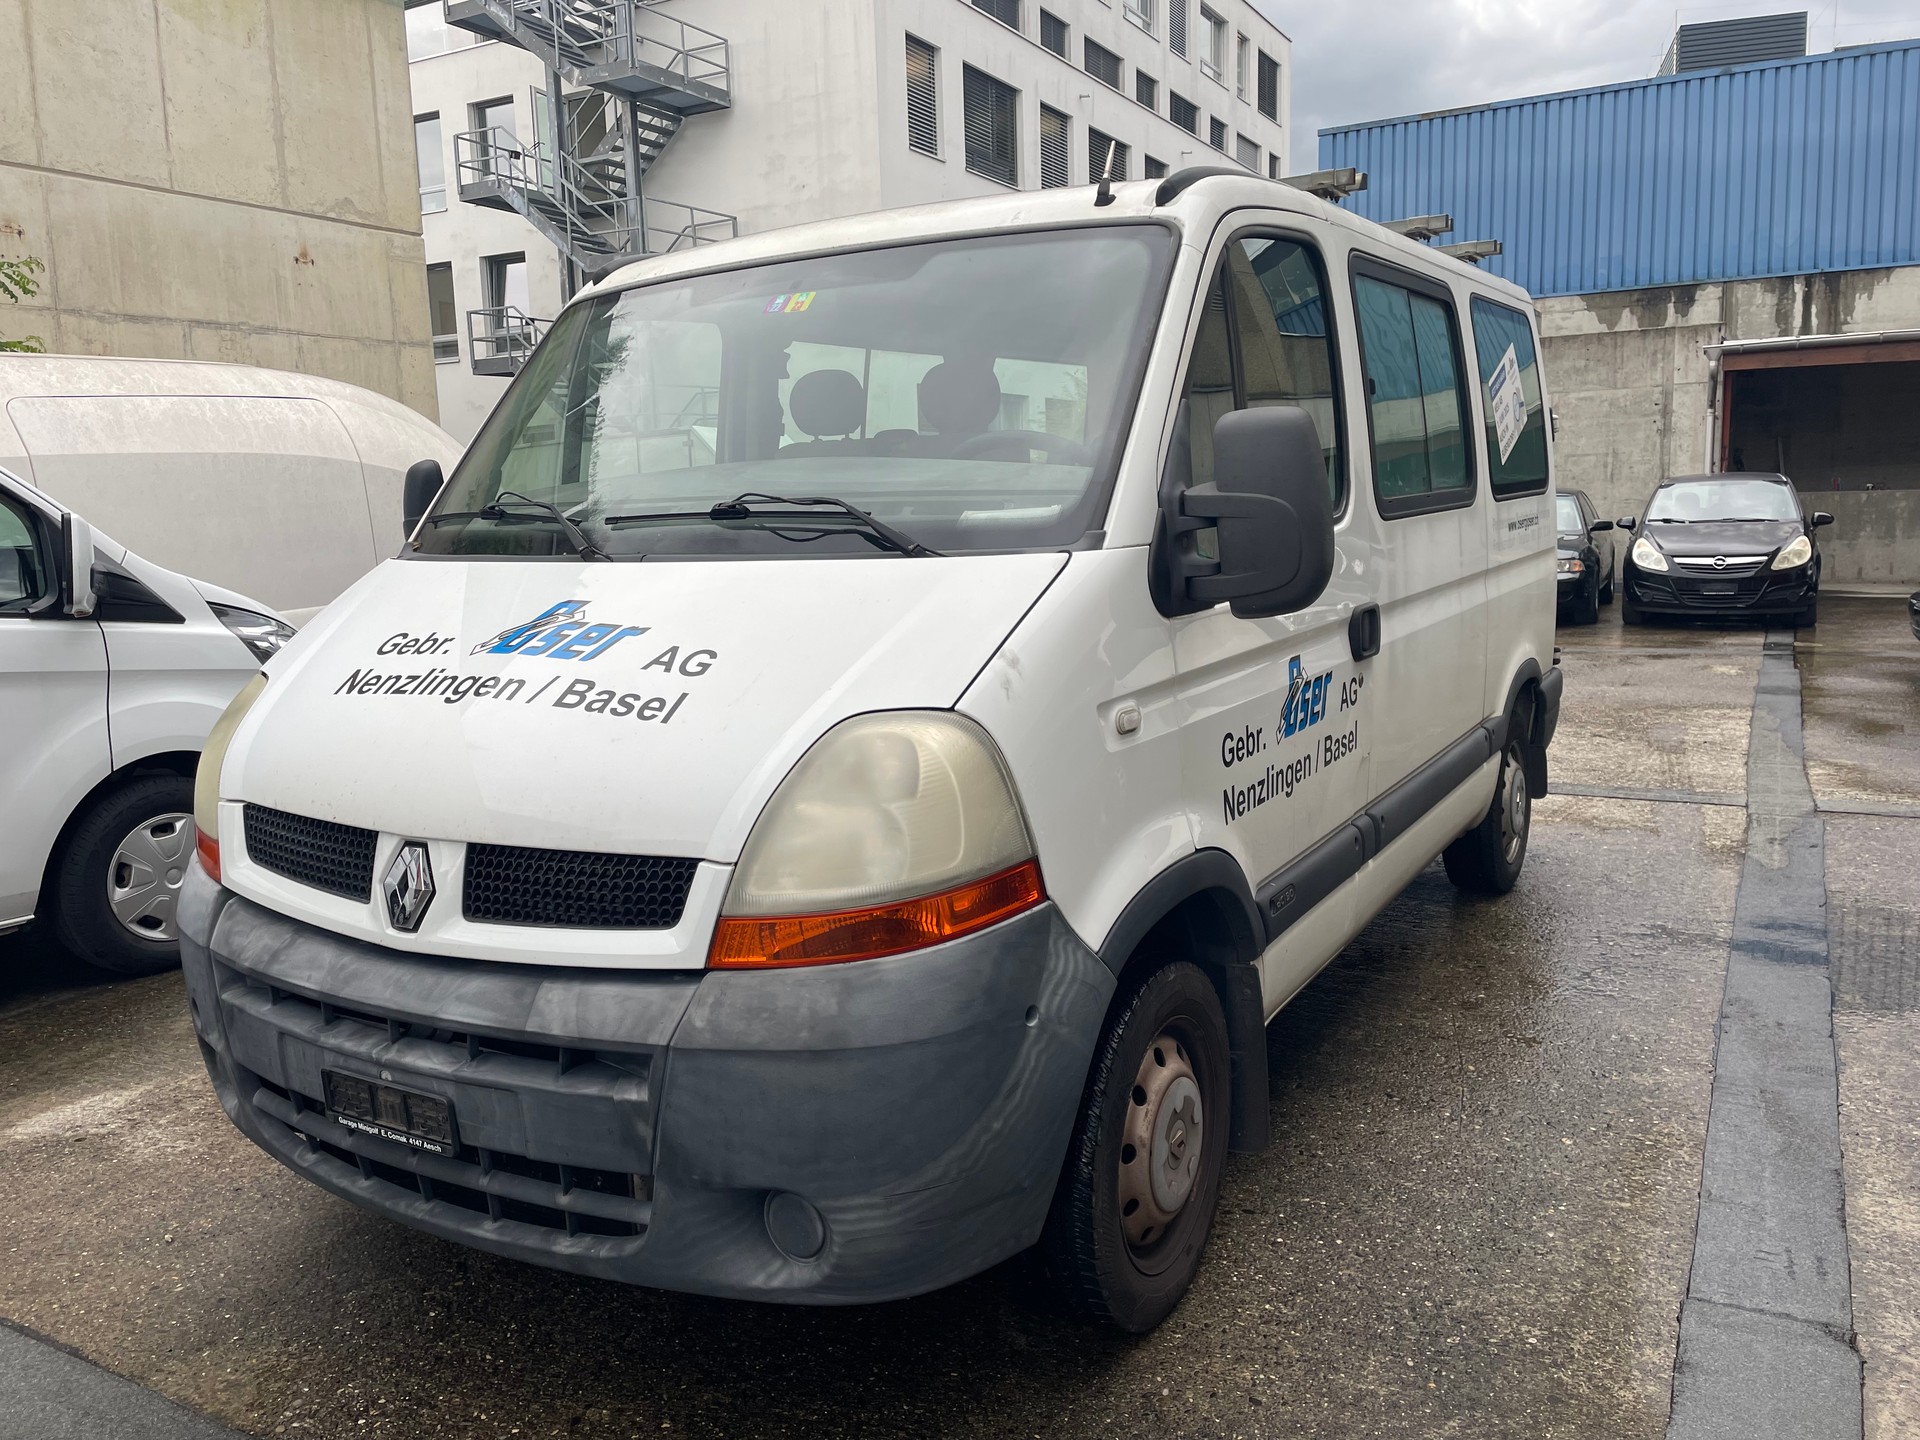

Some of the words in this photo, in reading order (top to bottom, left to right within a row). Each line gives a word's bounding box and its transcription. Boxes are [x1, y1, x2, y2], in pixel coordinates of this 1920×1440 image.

[377, 632, 456, 656] Gebr.
[641, 645, 718, 677] AG
[333, 668, 527, 704] Nenzlingen
[525, 676, 561, 704] /
[552, 679, 689, 724] Basel
[1222, 725, 1267, 768] Gebr.
[1340, 677, 1358, 712] AG
[1223, 753, 1311, 826] Nenzlingen
[1315, 740, 1321, 773] /
[1324, 720, 1358, 768] Basel
[338, 1116, 357, 1128] Garage
[357, 1122, 379, 1134] Minigolf
[409, 1138, 422, 1147] 4147
[423, 1141, 442, 1152] Aesch
